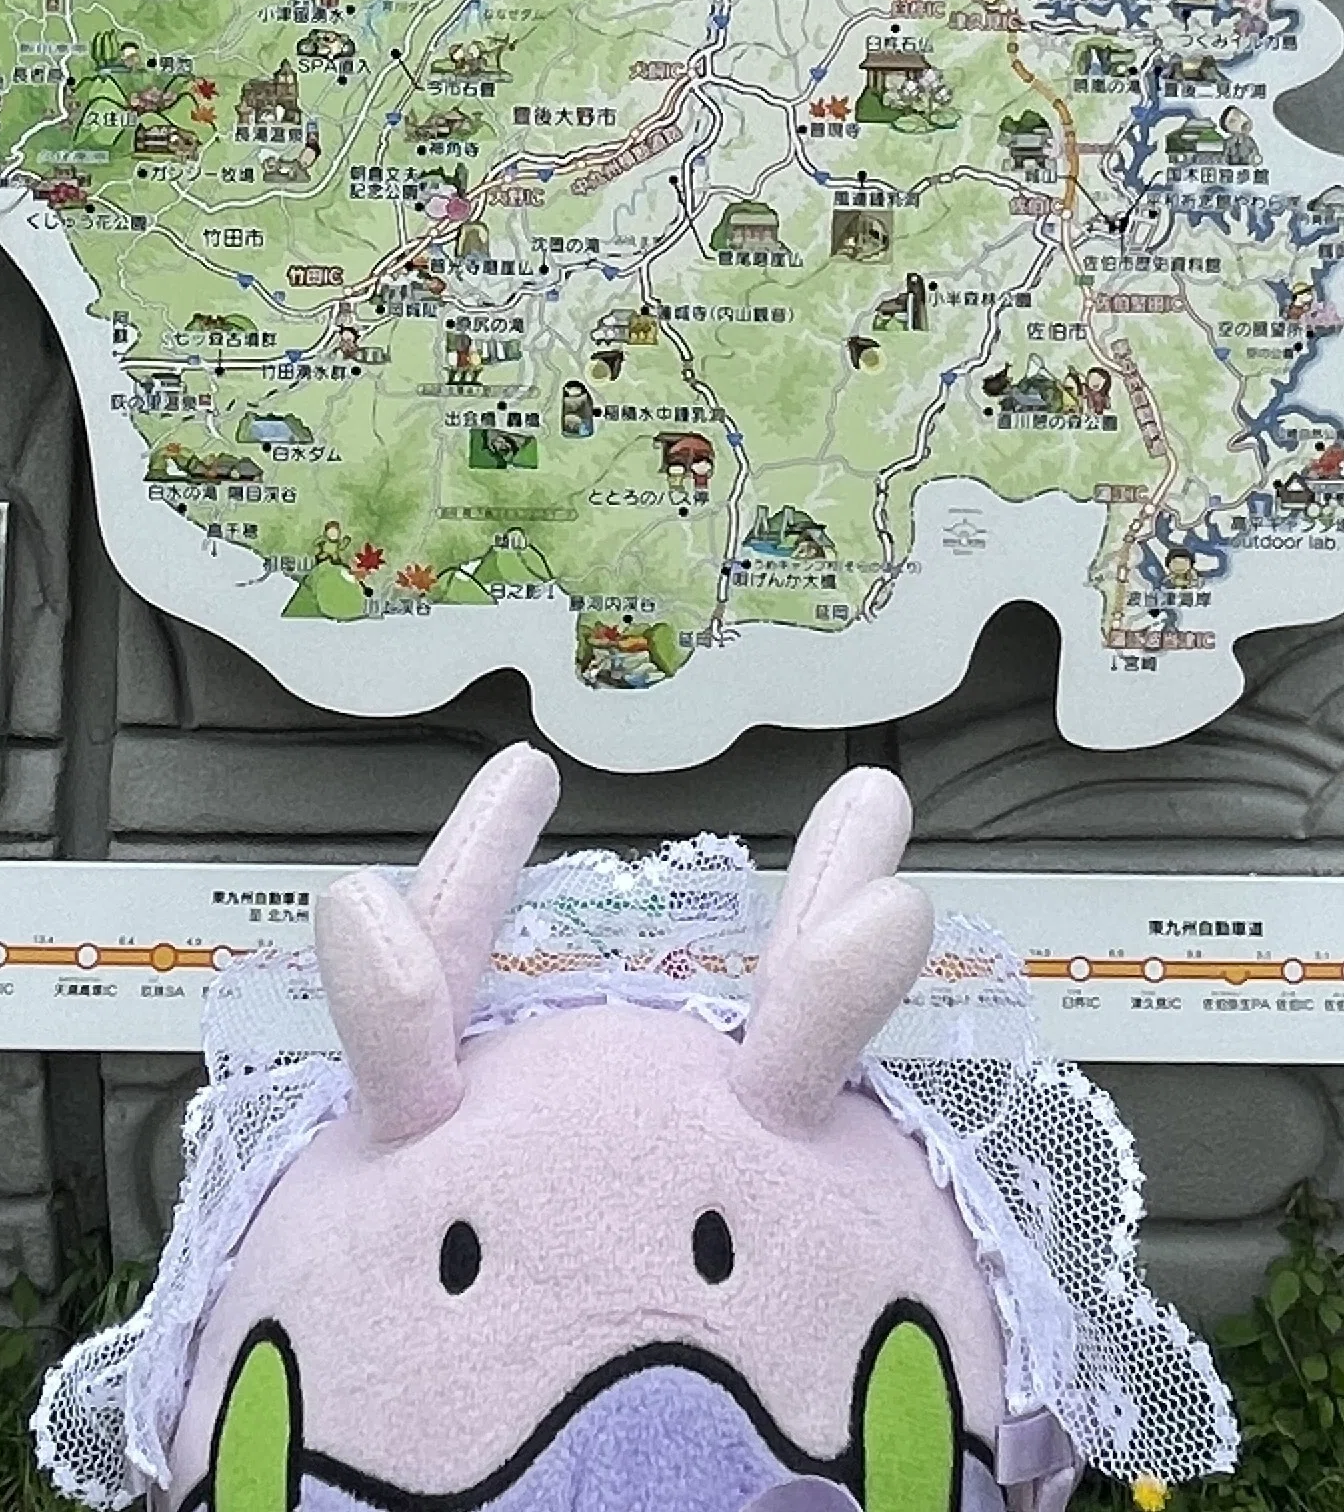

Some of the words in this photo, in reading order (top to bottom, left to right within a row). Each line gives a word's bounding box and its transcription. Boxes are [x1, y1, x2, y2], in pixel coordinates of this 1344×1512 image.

[513, 107, 617, 125] 豊後大野市
[203, 228, 264, 247] 竹田市
[287, 266, 345, 286] 竹田IC
[1027, 323, 1089, 340] 佐伯市
